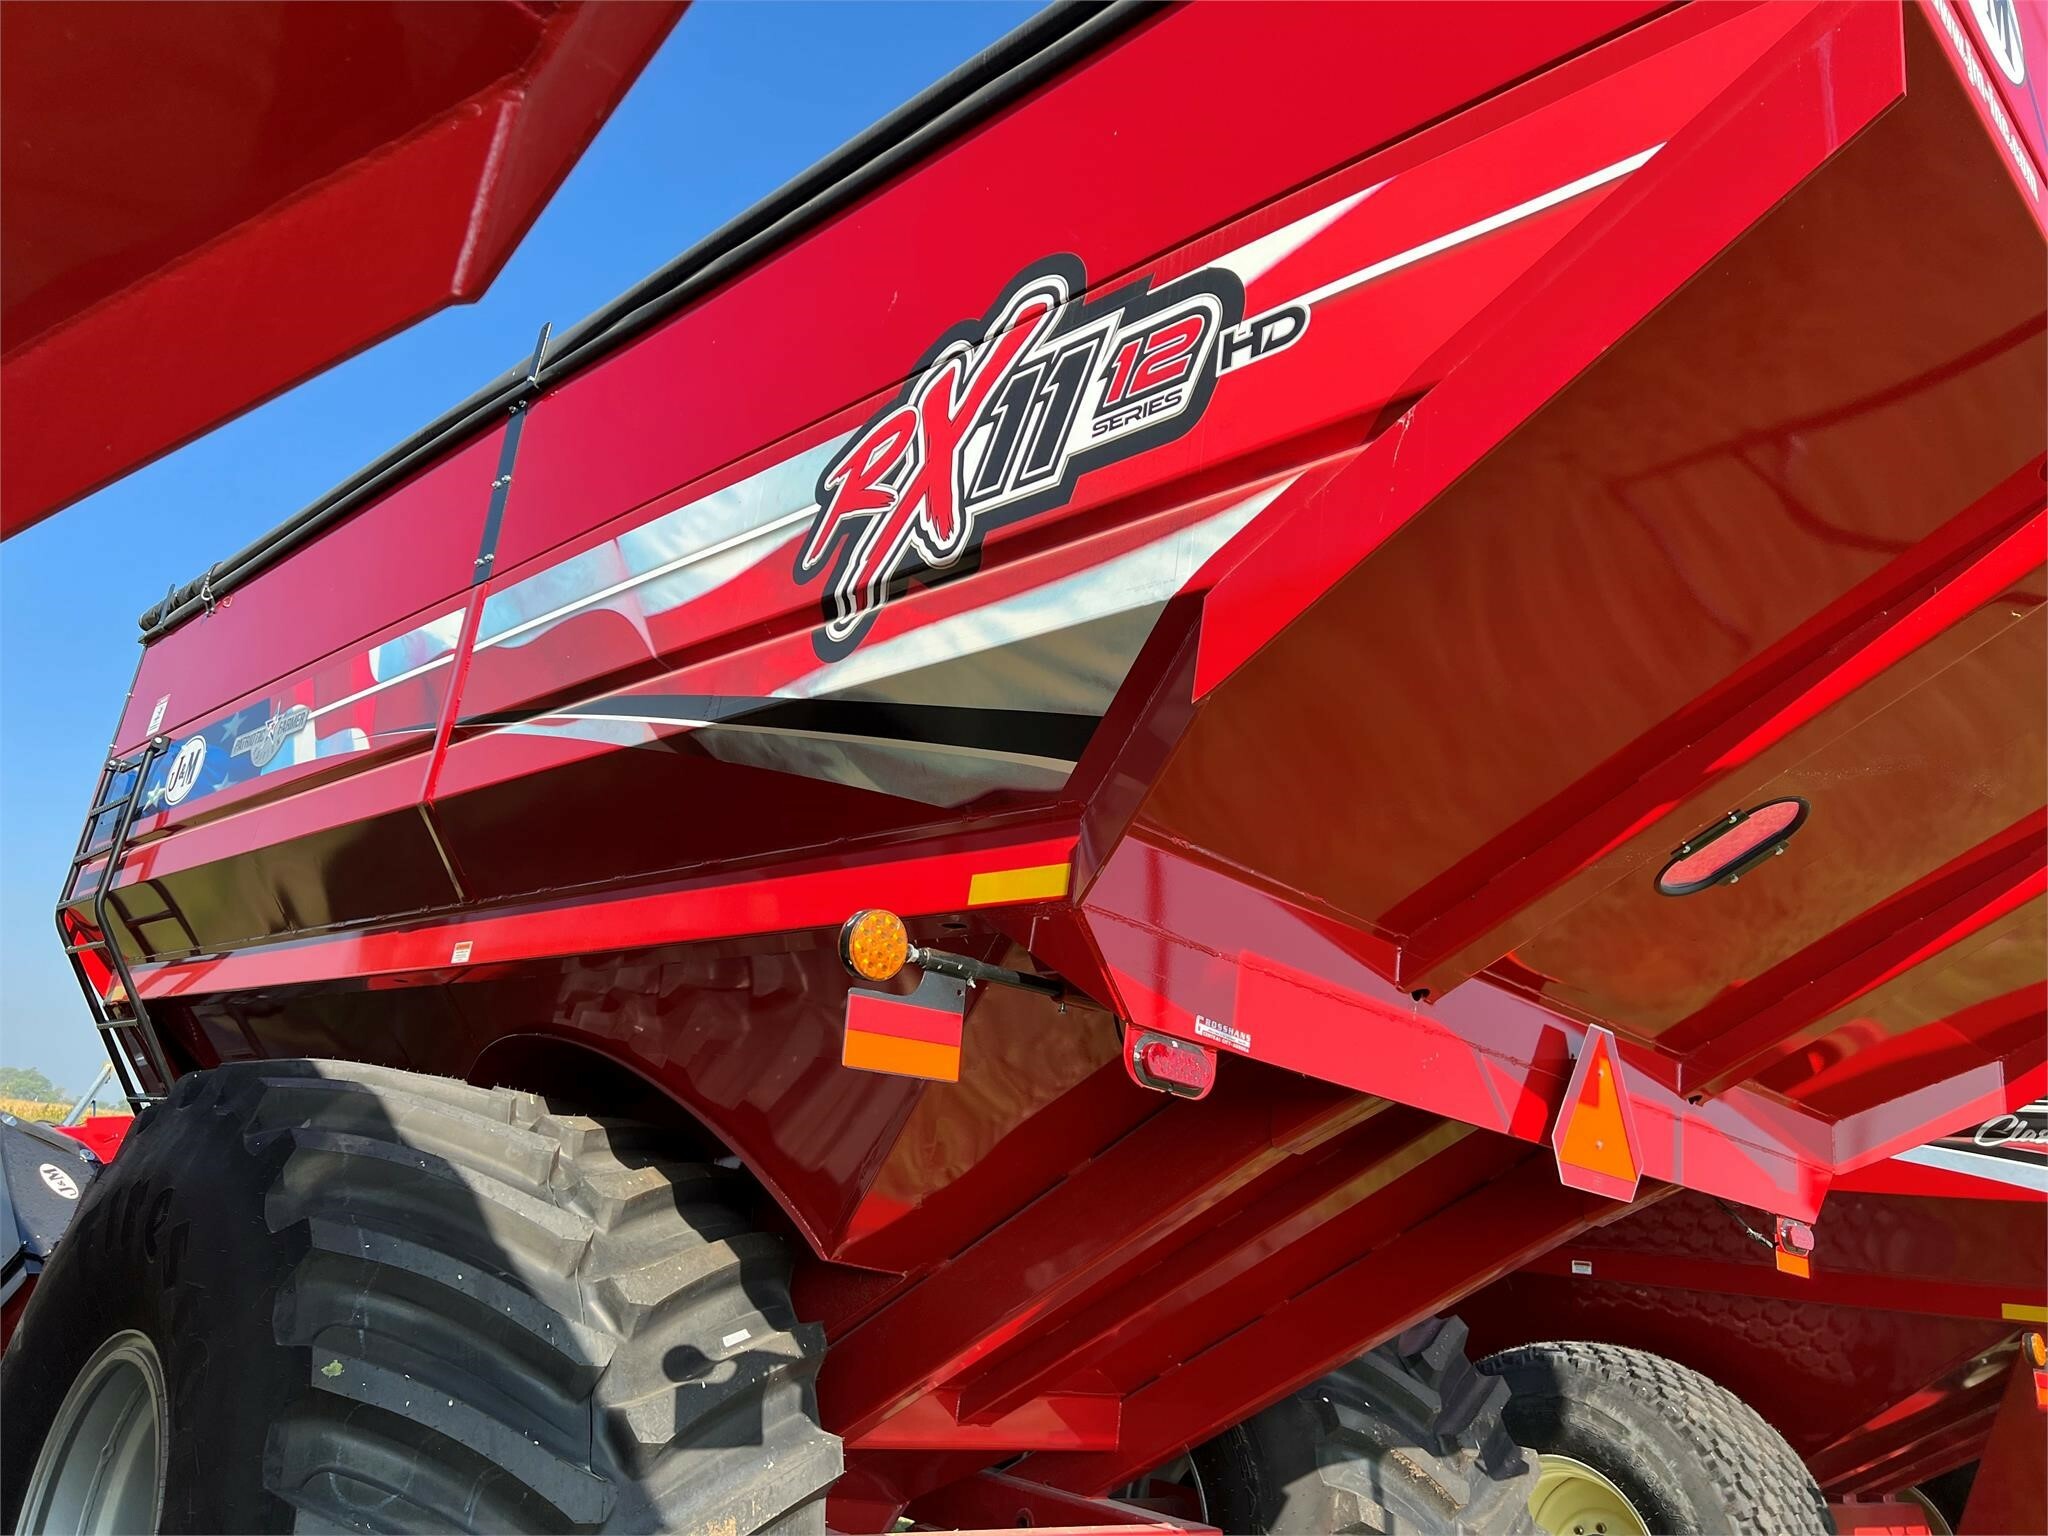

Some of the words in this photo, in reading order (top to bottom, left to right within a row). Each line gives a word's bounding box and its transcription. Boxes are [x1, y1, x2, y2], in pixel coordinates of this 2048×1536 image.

[1931, 0, 2038, 203] ww.jm-inc.com
[1218, 304, 1309, 372] HD
[1091, 388, 1183, 439] SERIES
[278, 711, 306, 734] FARMER
[168, 748, 202, 793] J&M
[1195, 1014, 1251, 1042] GROSSHANS
[42, 1168, 77, 1197] J&M
